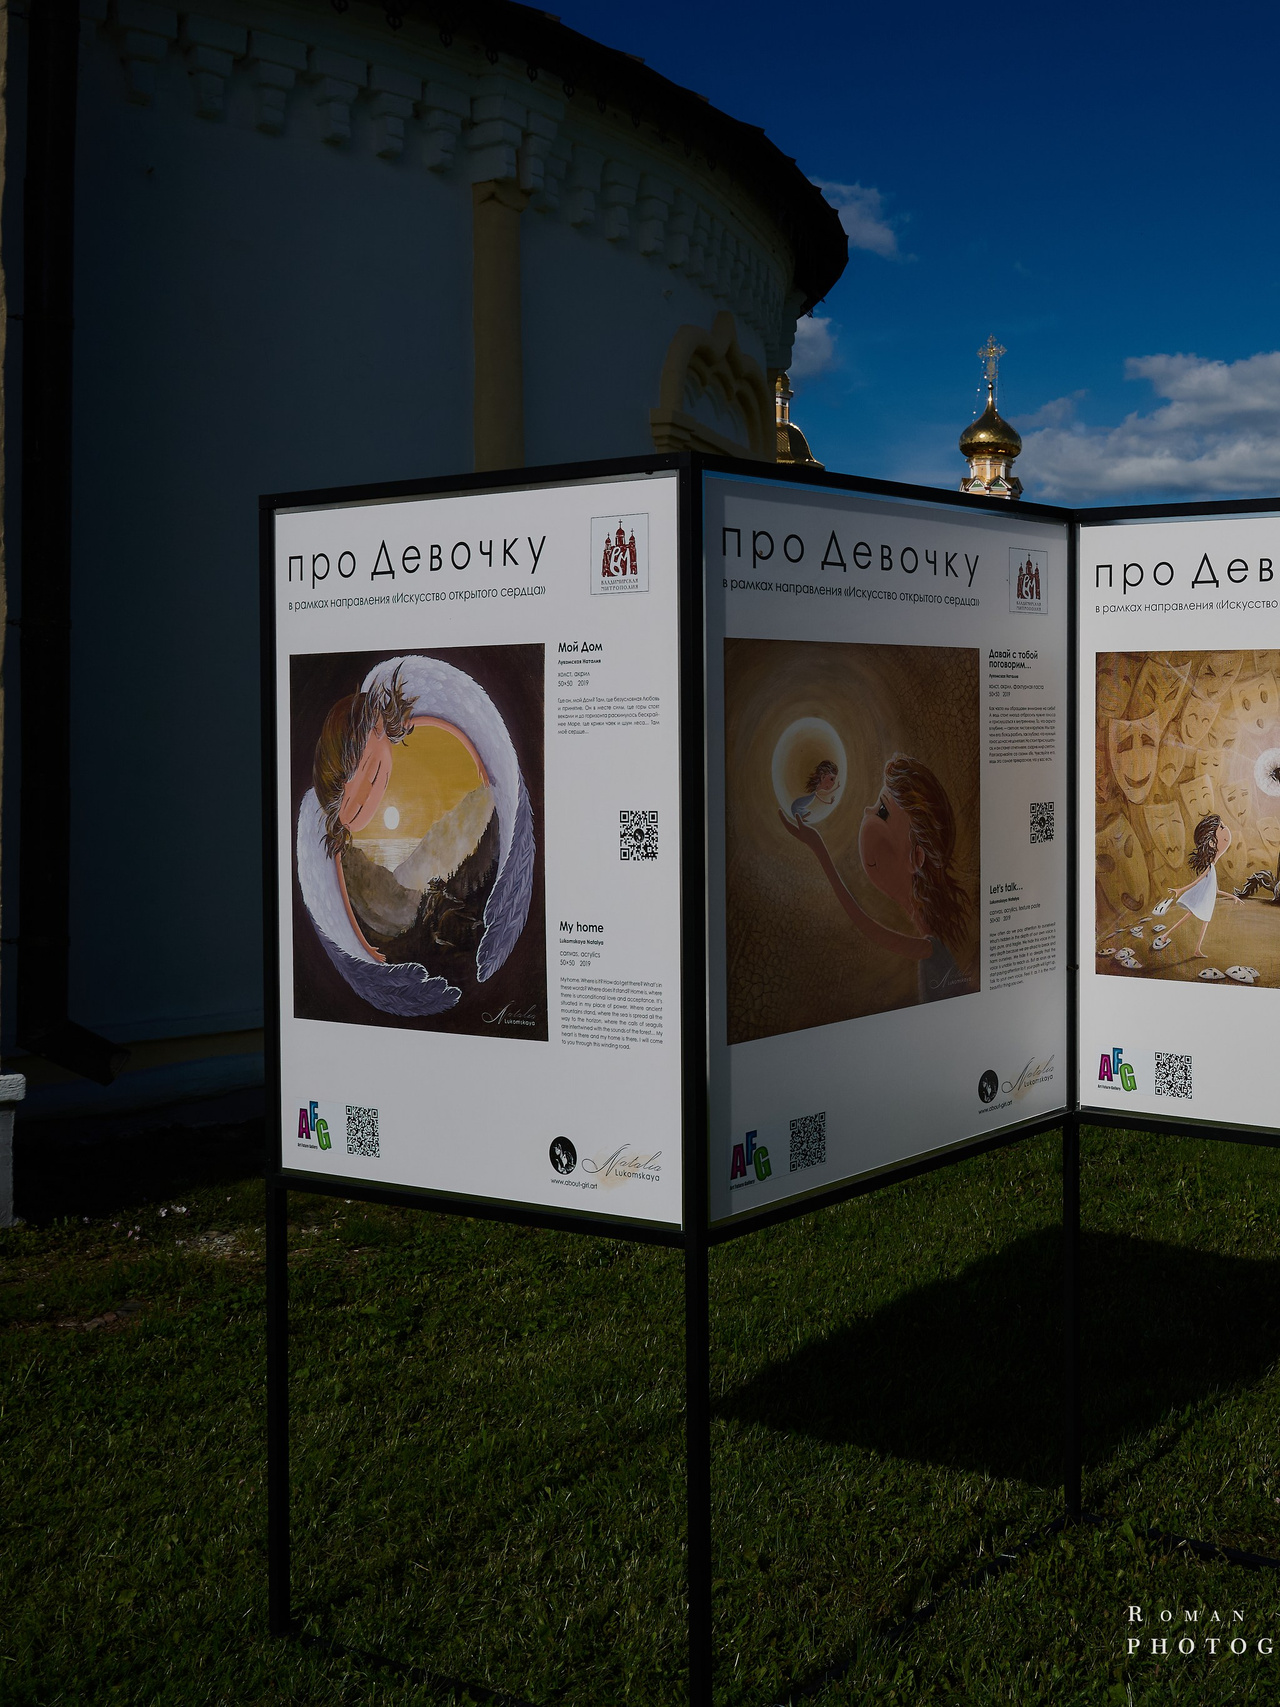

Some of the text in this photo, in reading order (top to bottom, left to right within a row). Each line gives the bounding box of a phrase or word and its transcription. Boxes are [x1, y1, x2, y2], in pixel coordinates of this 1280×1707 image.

[289, 536, 546, 589] про Девочку
[722, 527, 980, 587] про Девочку
[1095, 561, 1174, 594] про
[289, 586, 546, 612] в рамках направления «Искусство открытого сердца»
[722, 576, 979, 607] в рамках направления «Искусство открытого сердца»
[1103, 604, 1142, 615] рамках
[1145, 602, 1213, 613] направления
[1216, 600, 1278, 611] «Искусство
[558, 641, 602, 653] Мой Дом
[989, 649, 1010, 658] Давай
[1018, 650, 1038, 659] тобой
[989, 661, 1031, 670] поговорим...
[990, 883, 1023, 894] Let's talk...
[560, 921, 604, 934] My home
[1098, 1047, 1137, 1091] AFG
[298, 1101, 332, 1150] AFG
[582, 1143, 662, 1177] Natalia
[730, 1130, 772, 1181] AFG
[551, 1179, 597, 1189] www.about-girl.art
[615, 1169, 659, 1182] Lukomskaya
